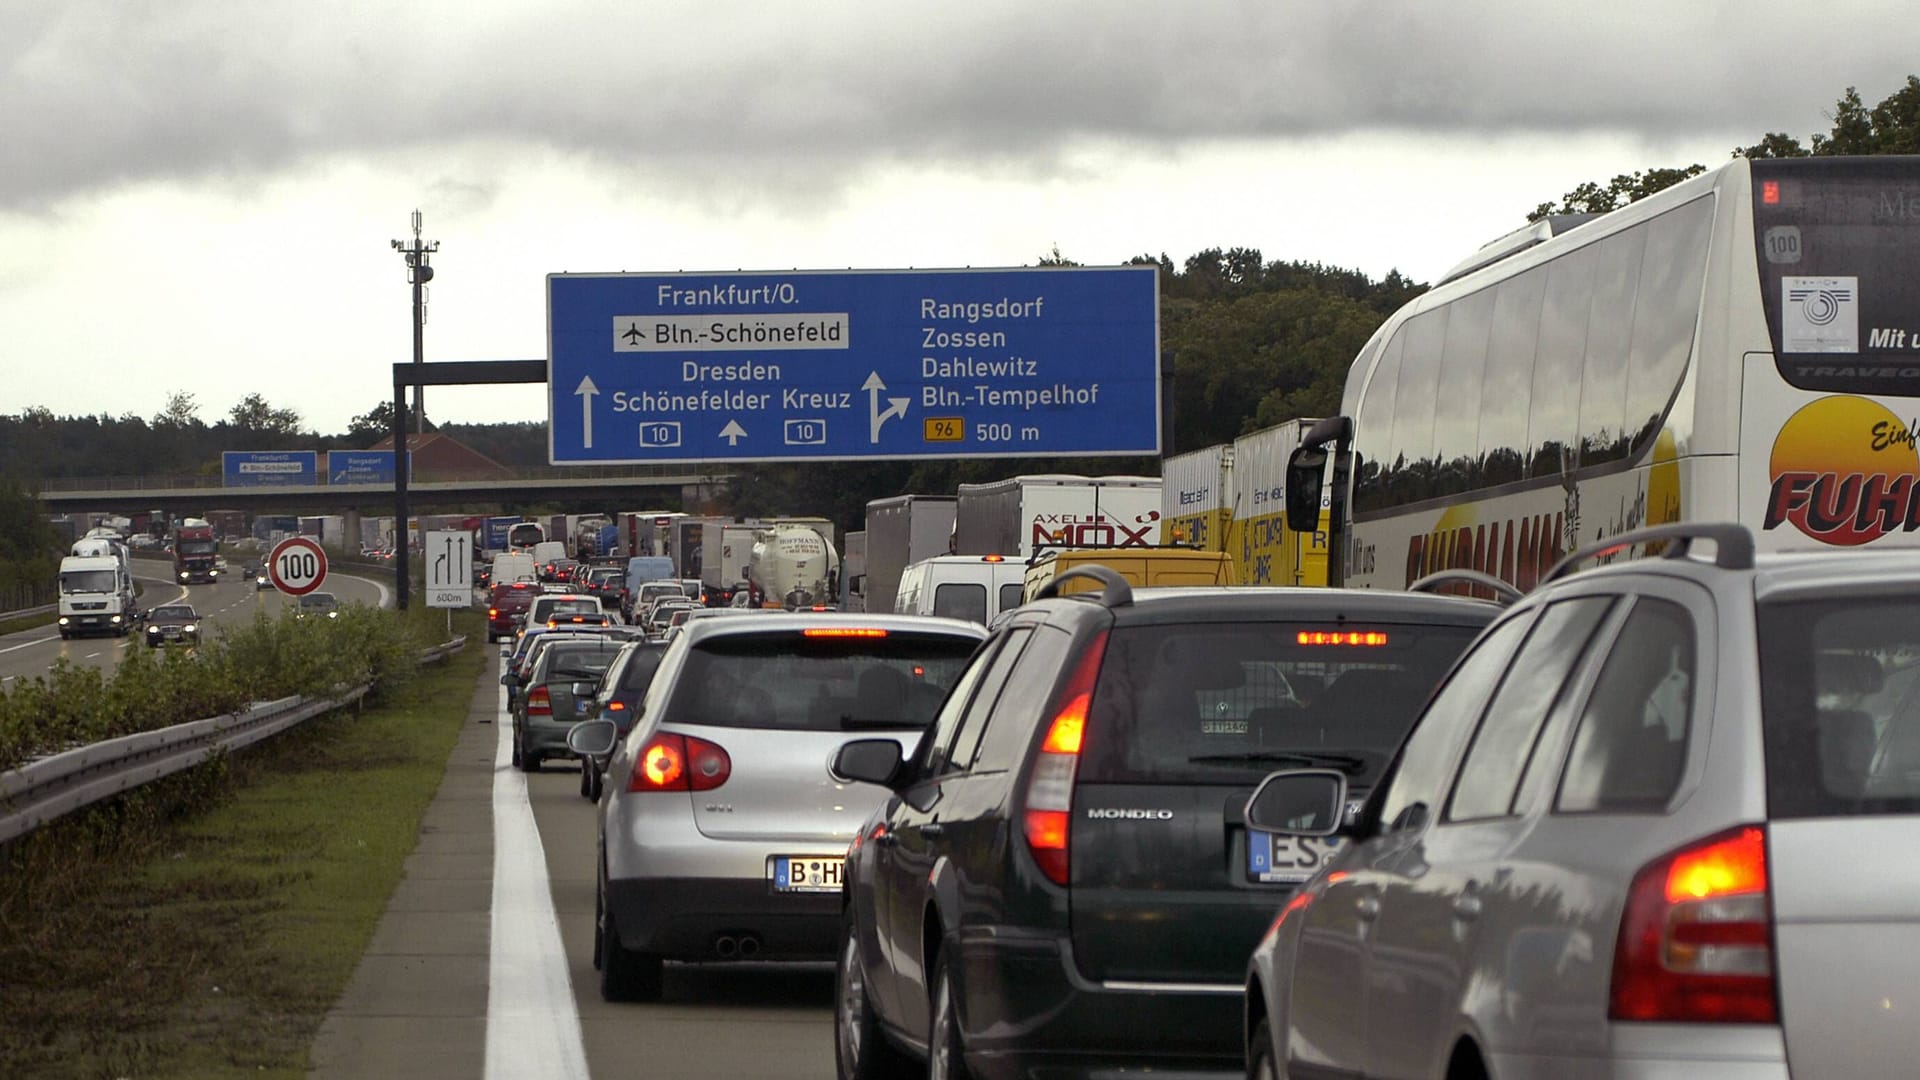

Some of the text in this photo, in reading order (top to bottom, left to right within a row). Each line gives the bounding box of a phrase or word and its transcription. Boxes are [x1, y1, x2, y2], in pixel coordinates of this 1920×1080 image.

[1769, 236, 1797, 253] 100
[658, 283, 800, 306] Frankfurt/O.
[921, 297, 1044, 323] Rangsdorf
[655, 321, 841, 344] Bln.-Schönefeld
[922, 328, 1006, 349] Zossen
[1868, 328, 1906, 348] Mit
[682, 361, 781, 383] Dresden
[922, 357, 1038, 378] Dahlewitz
[612, 388, 851, 412] Schönefelder Kreuz
[922, 384, 1099, 411] Bln.-Tempelhof
[652, 427, 669, 442] 10
[797, 425, 814, 440] 10
[934, 422, 954, 437] 96
[976, 423, 1040, 441] 500 m
[1871, 418, 1920, 452] Einf
[1033, 513, 1096, 524] AXEL
[279, 554, 316, 580] 100
[1088, 808, 1174, 820] MONDEO
[1270, 832, 1320, 868] ES
[791, 862, 806, 883] B
